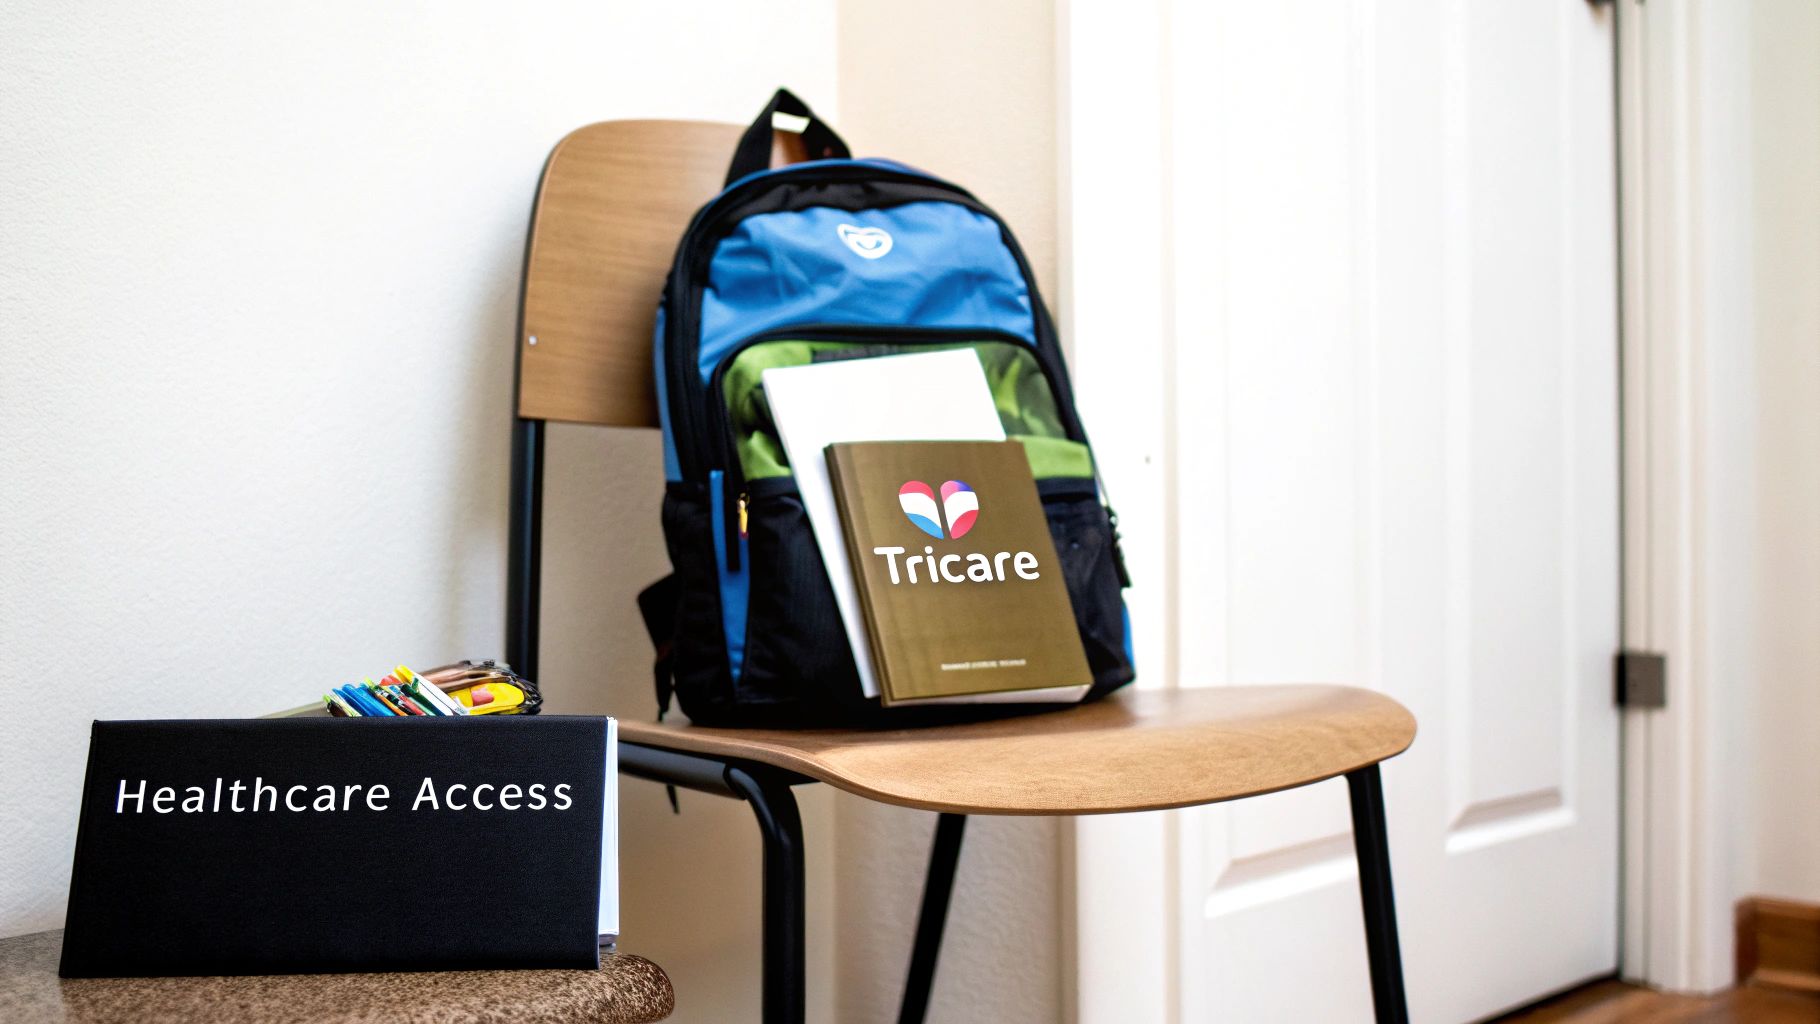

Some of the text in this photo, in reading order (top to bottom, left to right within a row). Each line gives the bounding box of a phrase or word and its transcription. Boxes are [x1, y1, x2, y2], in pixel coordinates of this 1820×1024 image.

[873, 546, 1040, 585] Tricare
[116, 777, 573, 814] Healthcare Access
